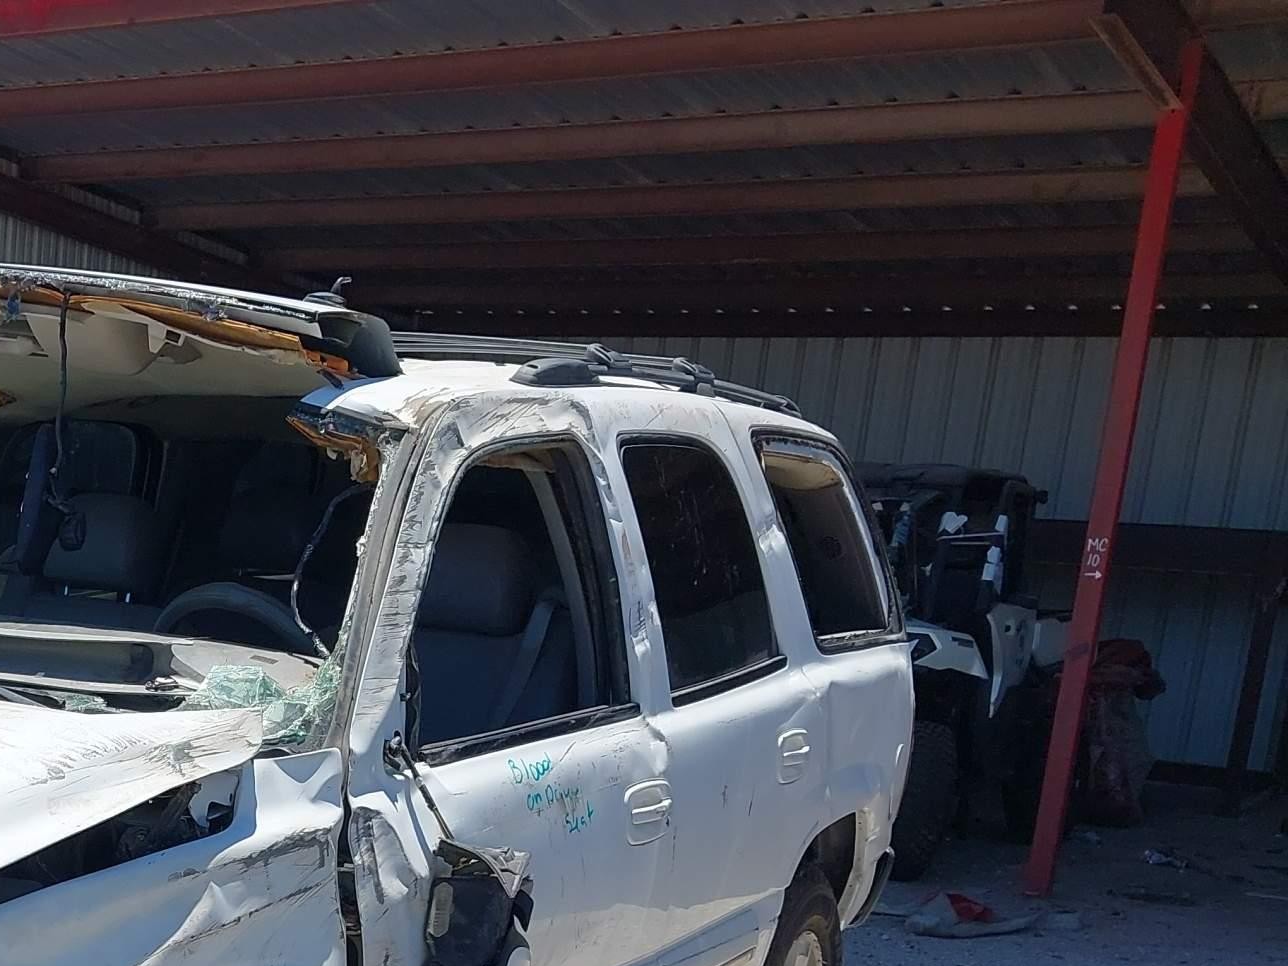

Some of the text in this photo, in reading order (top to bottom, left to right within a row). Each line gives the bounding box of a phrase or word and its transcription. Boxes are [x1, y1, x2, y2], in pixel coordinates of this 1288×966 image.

[1087, 537, 1109, 552] MC
[1086, 553, 1101, 567] 10
[507, 751, 553, 784] Blood
